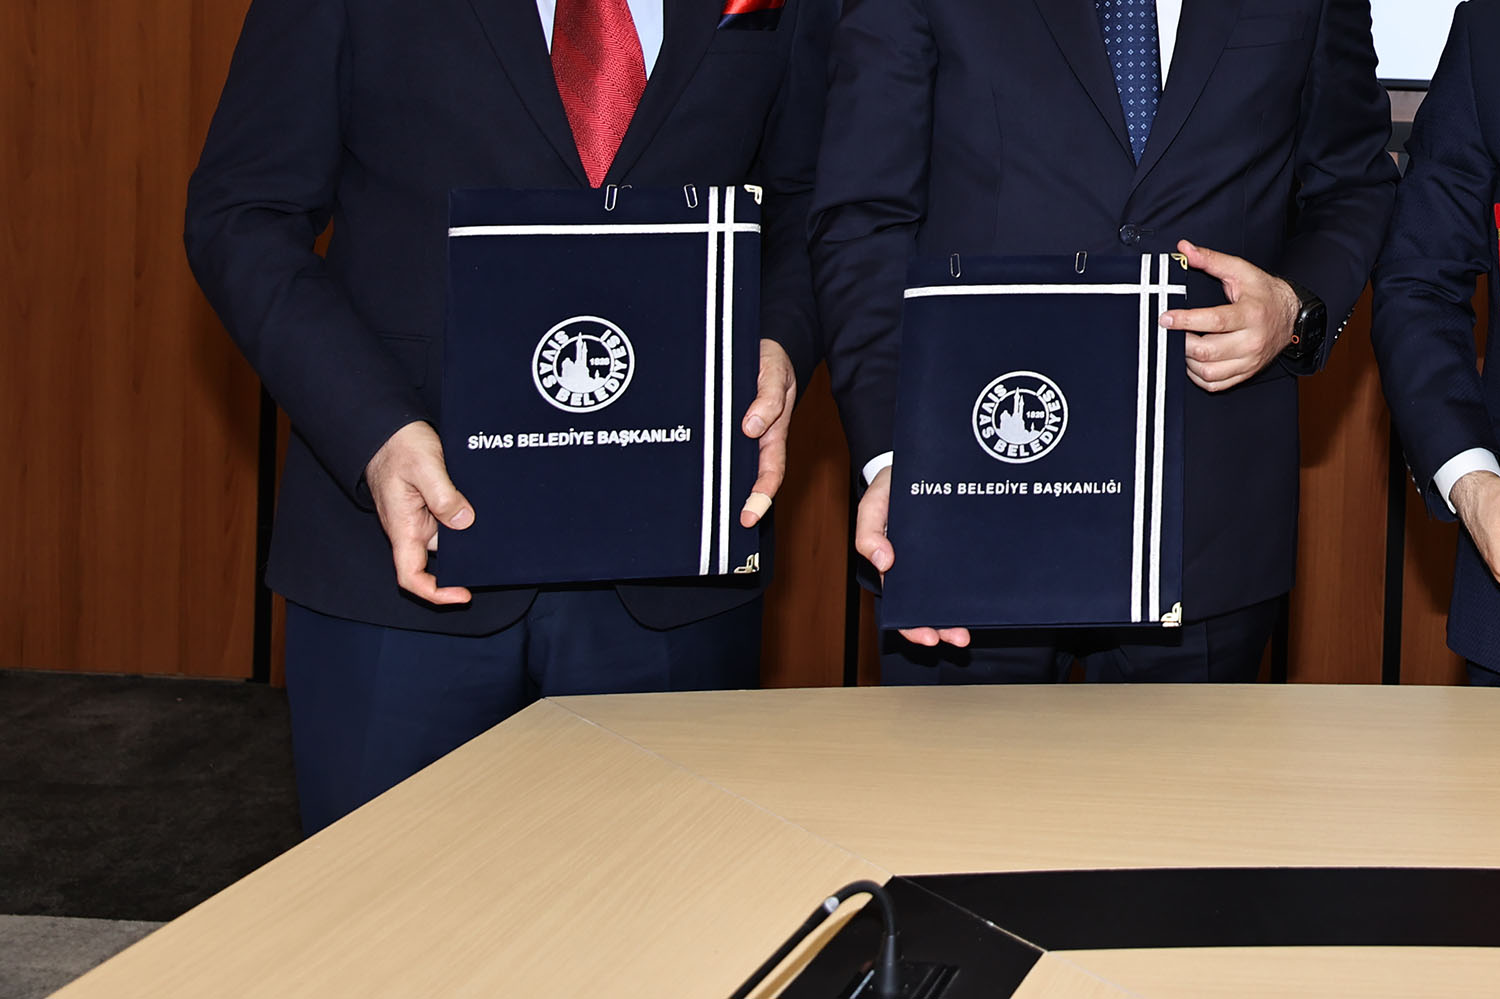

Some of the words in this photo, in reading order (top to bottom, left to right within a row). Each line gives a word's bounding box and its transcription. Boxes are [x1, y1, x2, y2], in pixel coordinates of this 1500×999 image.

[467, 431, 514, 450] SİVAS
[517, 427, 594, 448] BELEDİYE
[597, 424, 691, 447] BAŞKANLIĞI
[910, 480, 952, 495] SİVAS
[957, 479, 1028, 495] BELEDİYE
[1033, 479, 1122, 498] BAŞKANLIĞI
